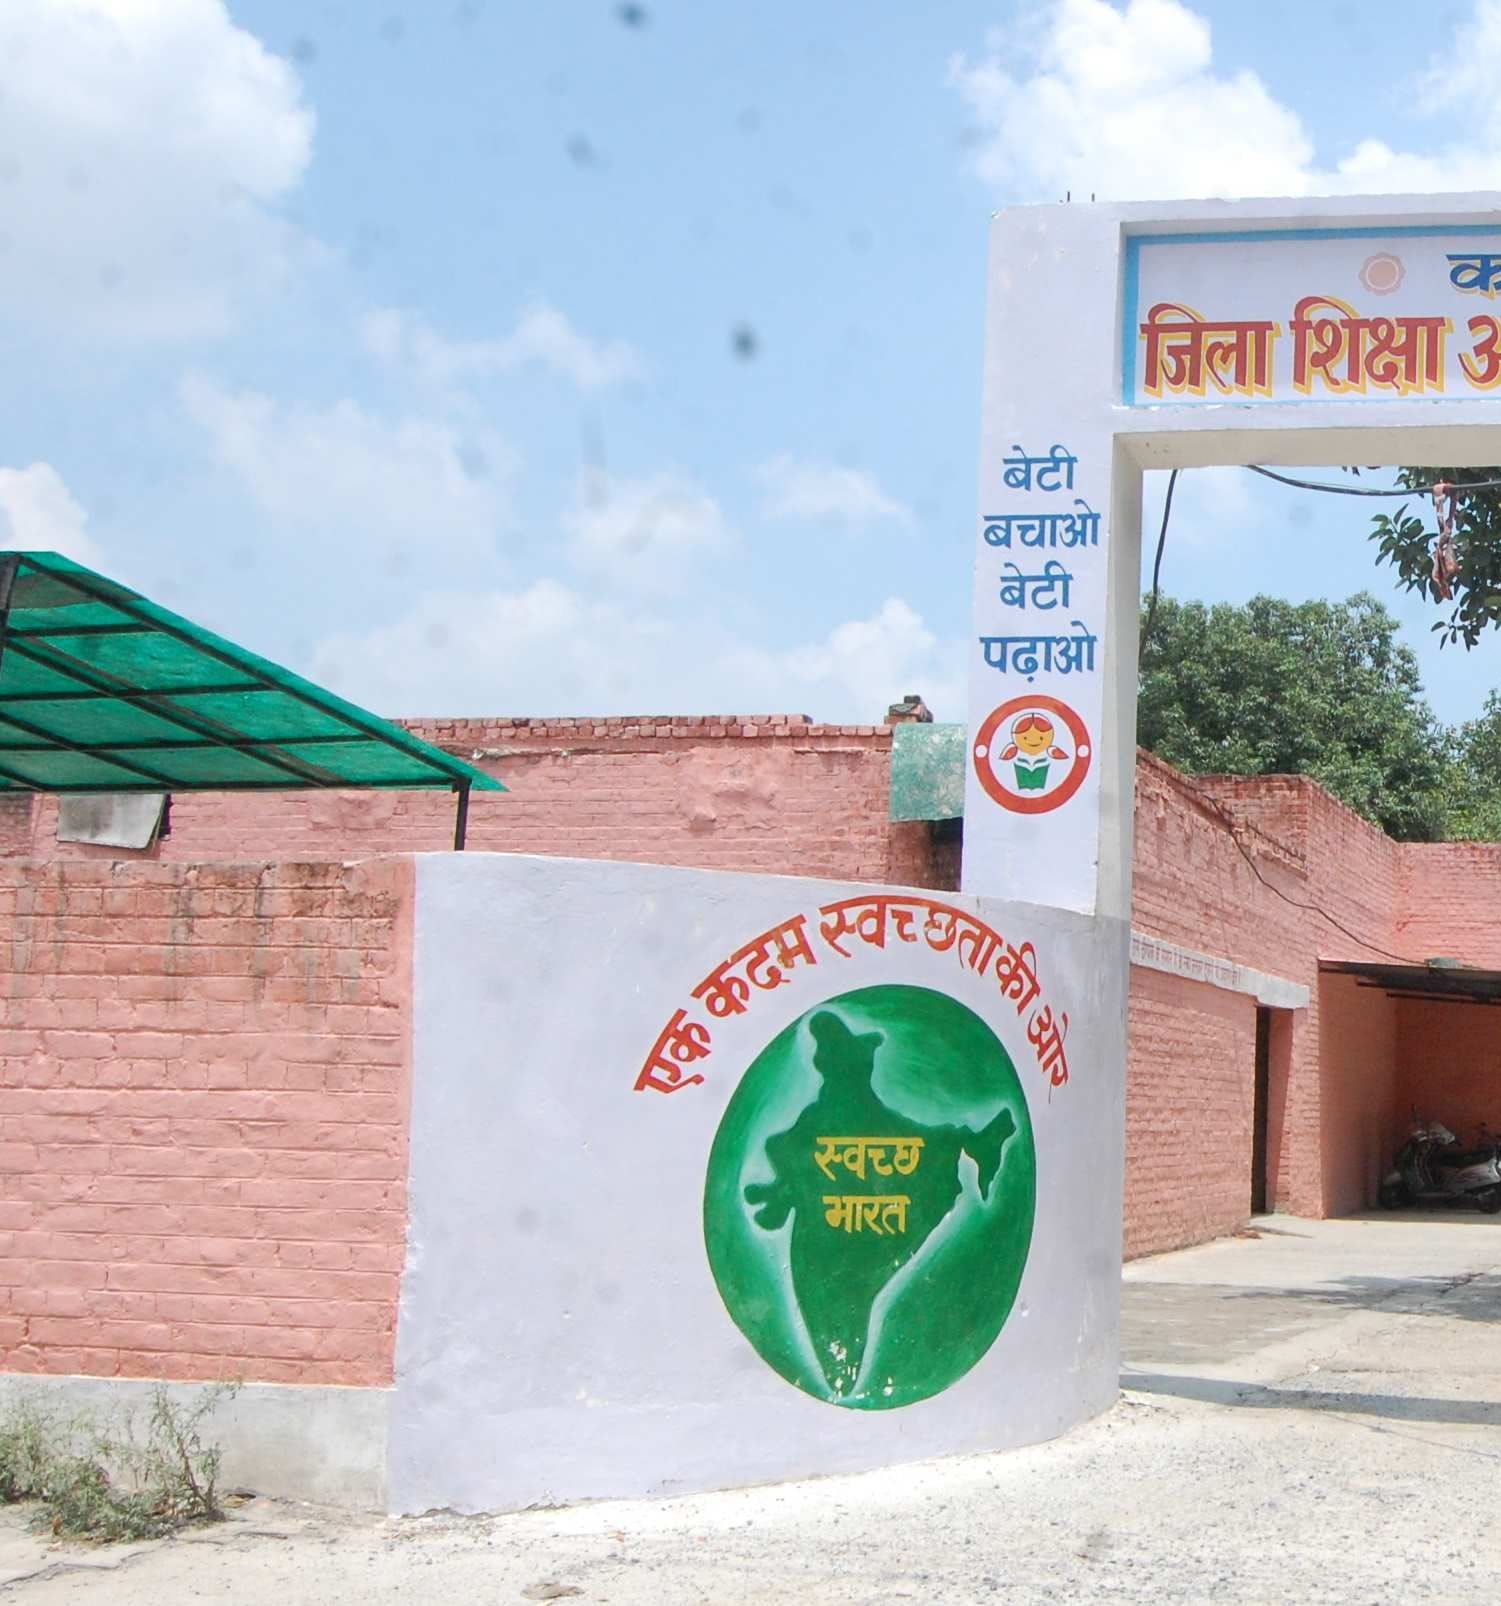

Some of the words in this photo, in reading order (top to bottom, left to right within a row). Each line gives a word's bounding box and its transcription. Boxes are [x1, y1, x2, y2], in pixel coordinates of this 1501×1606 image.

[1141, 302, 1275, 392] जिला
[1291, 296, 1448, 391] शिक्षा
[1002, 444, 1078, 492] बेटी
[983, 498, 1101, 549] बचाओ
[1000, 559, 1074, 610] बेटी
[980, 620, 1098, 683] पढ़ाओ
[634, 1008, 712, 1094] एक
[691, 914, 817, 1018] कदम
[820, 895, 1004, 977] स्वच्छता
[996, 942, 1041, 1016] की
[1027, 1004, 1069, 1104] ओर
[814, 1136, 924, 1180] स्वच्छ
[822, 1194, 912, 1235] भारत
